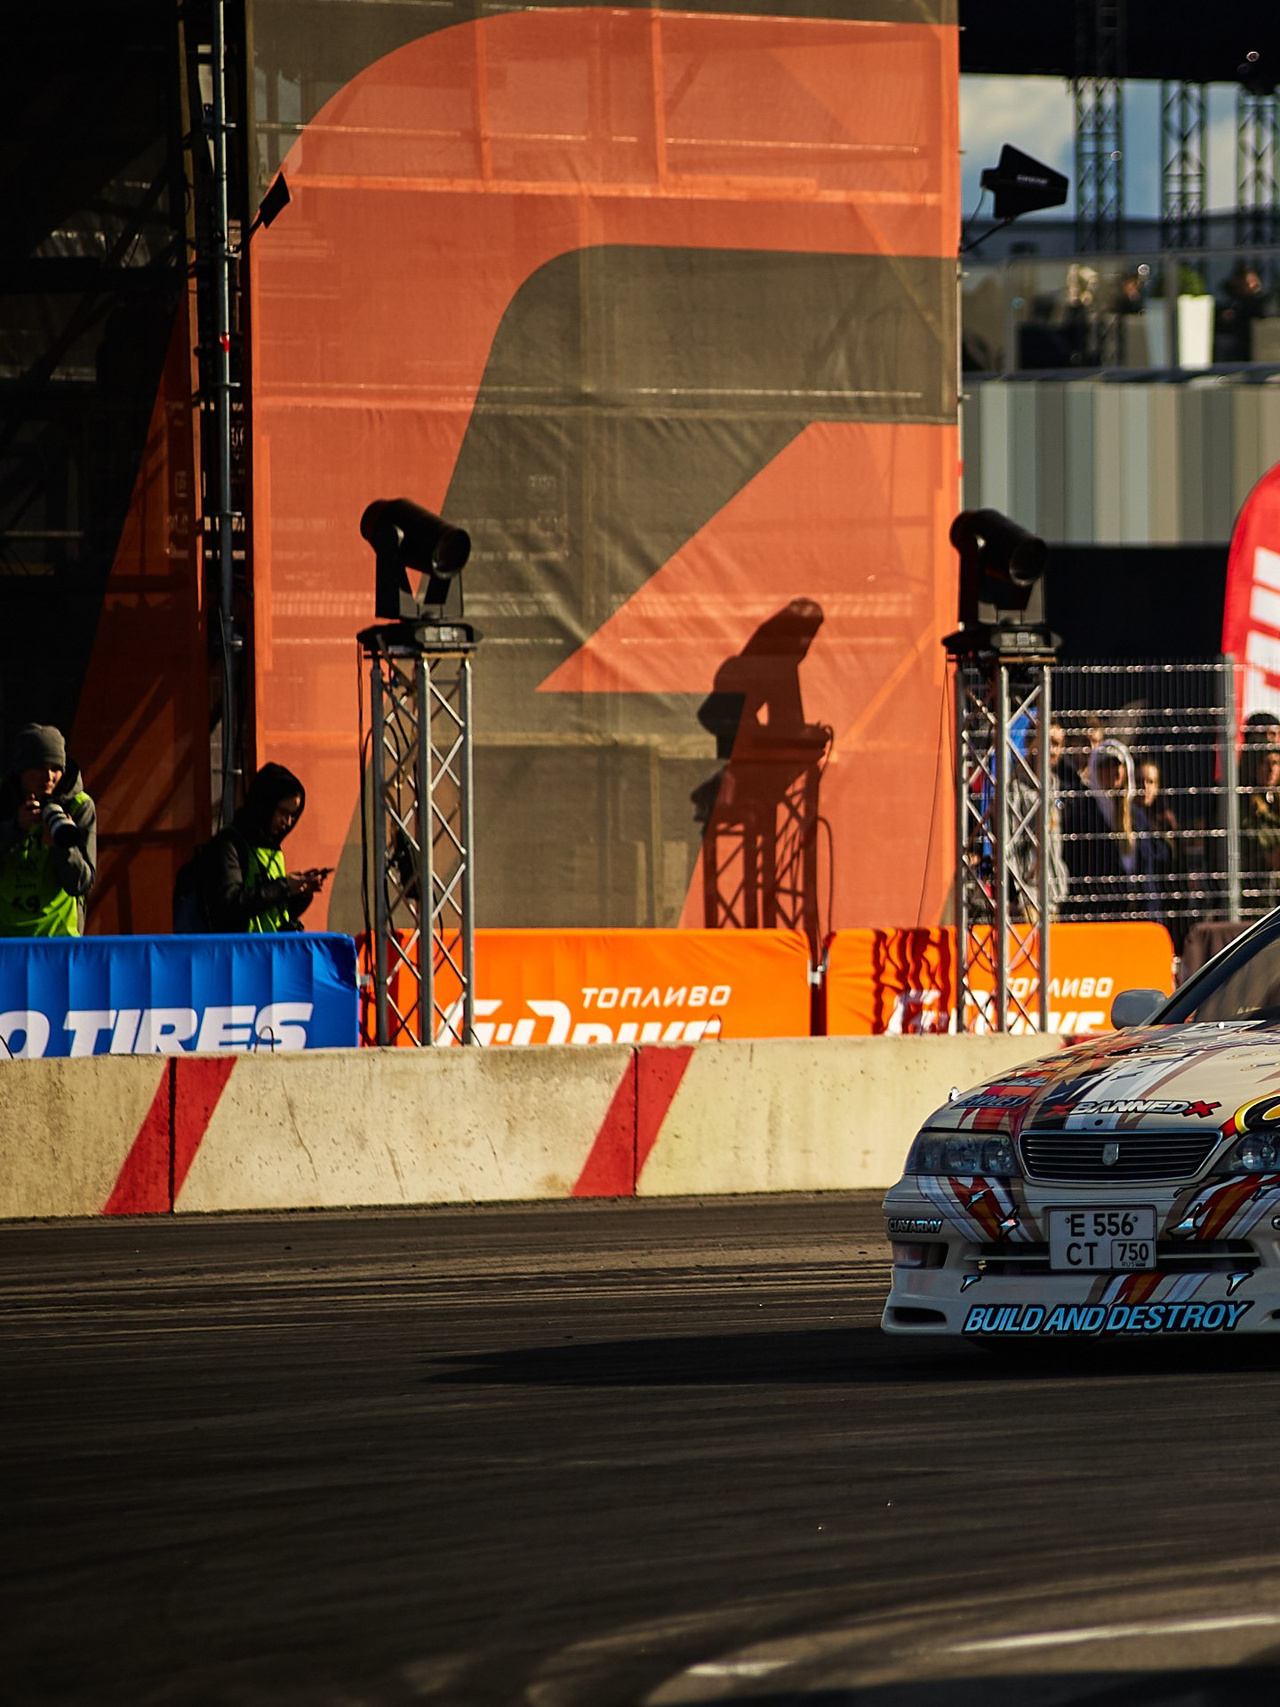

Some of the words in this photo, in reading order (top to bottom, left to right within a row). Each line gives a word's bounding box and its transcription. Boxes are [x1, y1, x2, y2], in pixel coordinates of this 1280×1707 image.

[581, 985, 732, 1009] ТОПЛИВО
[63, 1002, 313, 1058] TIRES
[1093, 1212, 1134, 1237] 556
[1117, 1242, 1149, 1262] 750
[964, 1304, 1043, 1332] BUILD
[1043, 1304, 1103, 1331] AND
[1106, 1302, 1249, 1330] DESTROY
